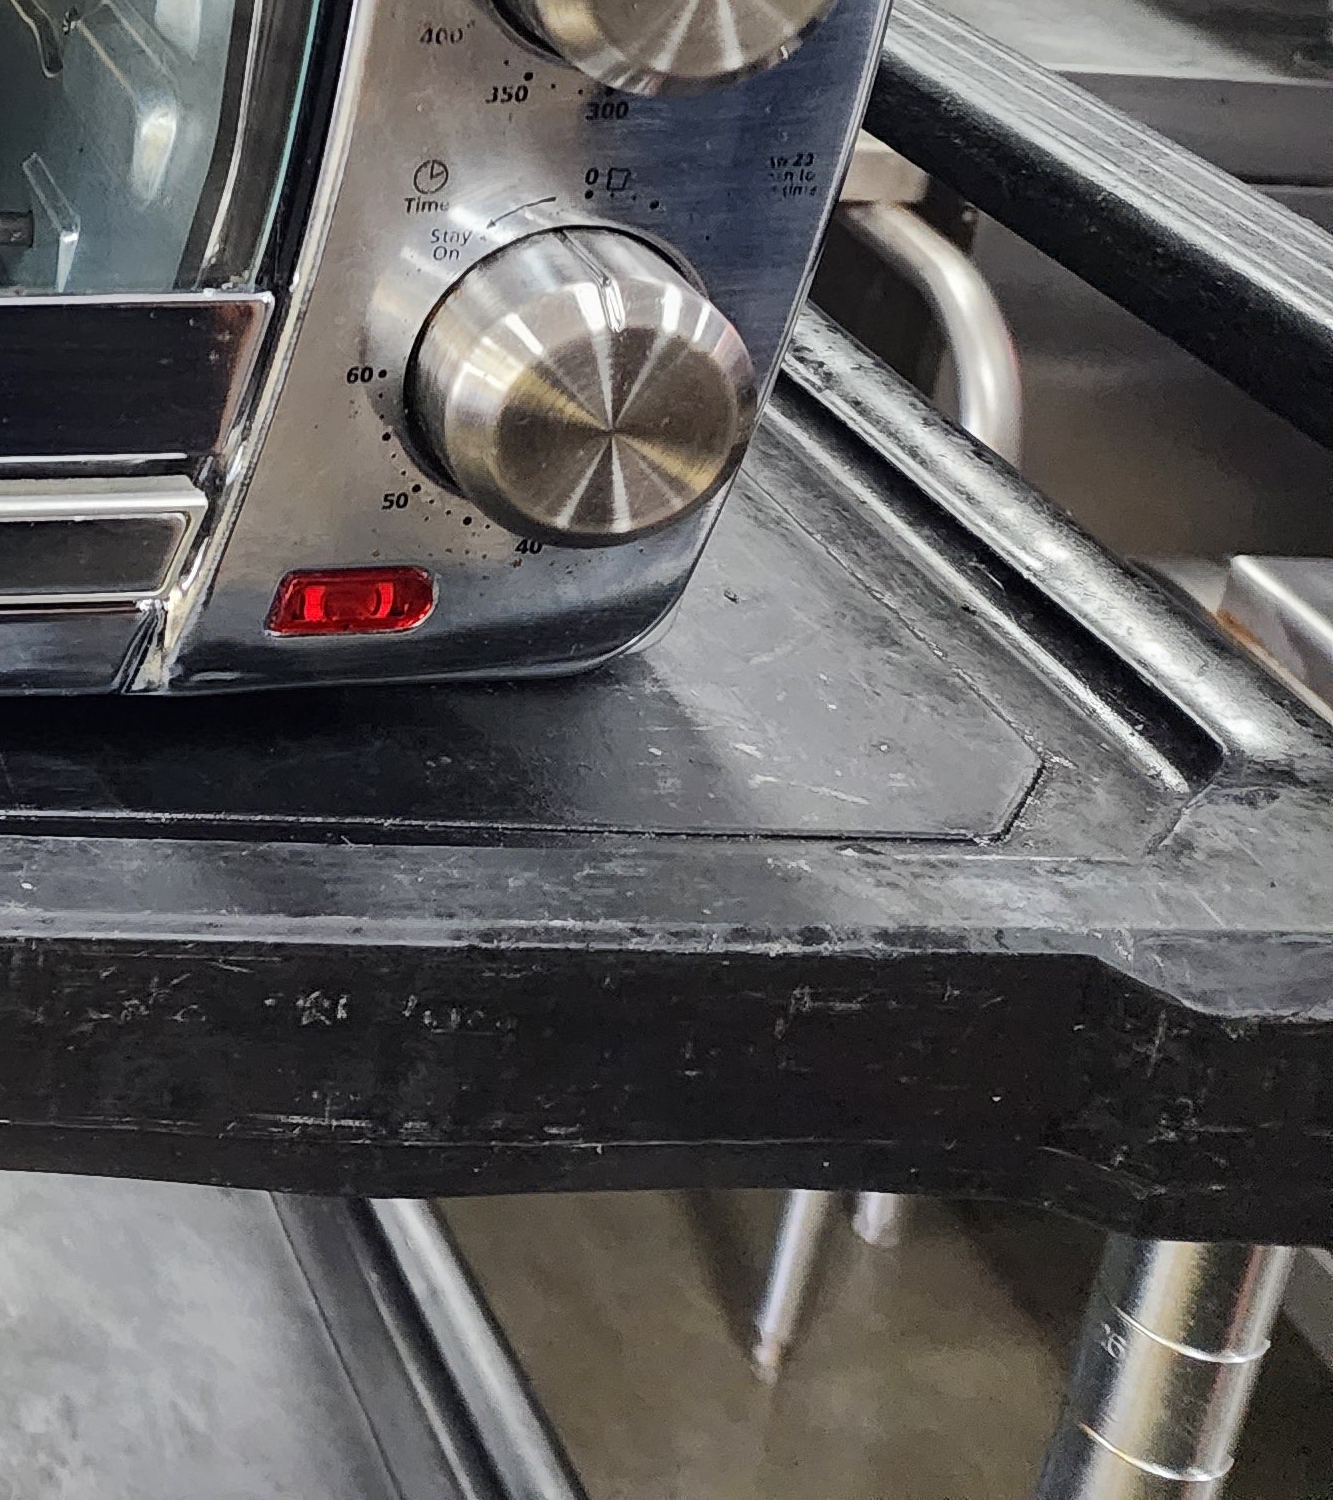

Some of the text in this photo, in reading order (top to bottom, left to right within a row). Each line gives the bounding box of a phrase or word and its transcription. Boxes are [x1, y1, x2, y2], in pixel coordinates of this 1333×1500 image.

[420, 26, 464, 46] 400
[484, 84, 529, 105] 350
[584, 101, 630, 121] 300
[404, 195, 451, 215] Time
[429, 228, 474, 246] Stay
[432, 245, 461, 262] On
[345, 366, 375, 386] 60
[381, 492, 410, 511] 50
[514, 538, 544, 556] 40
